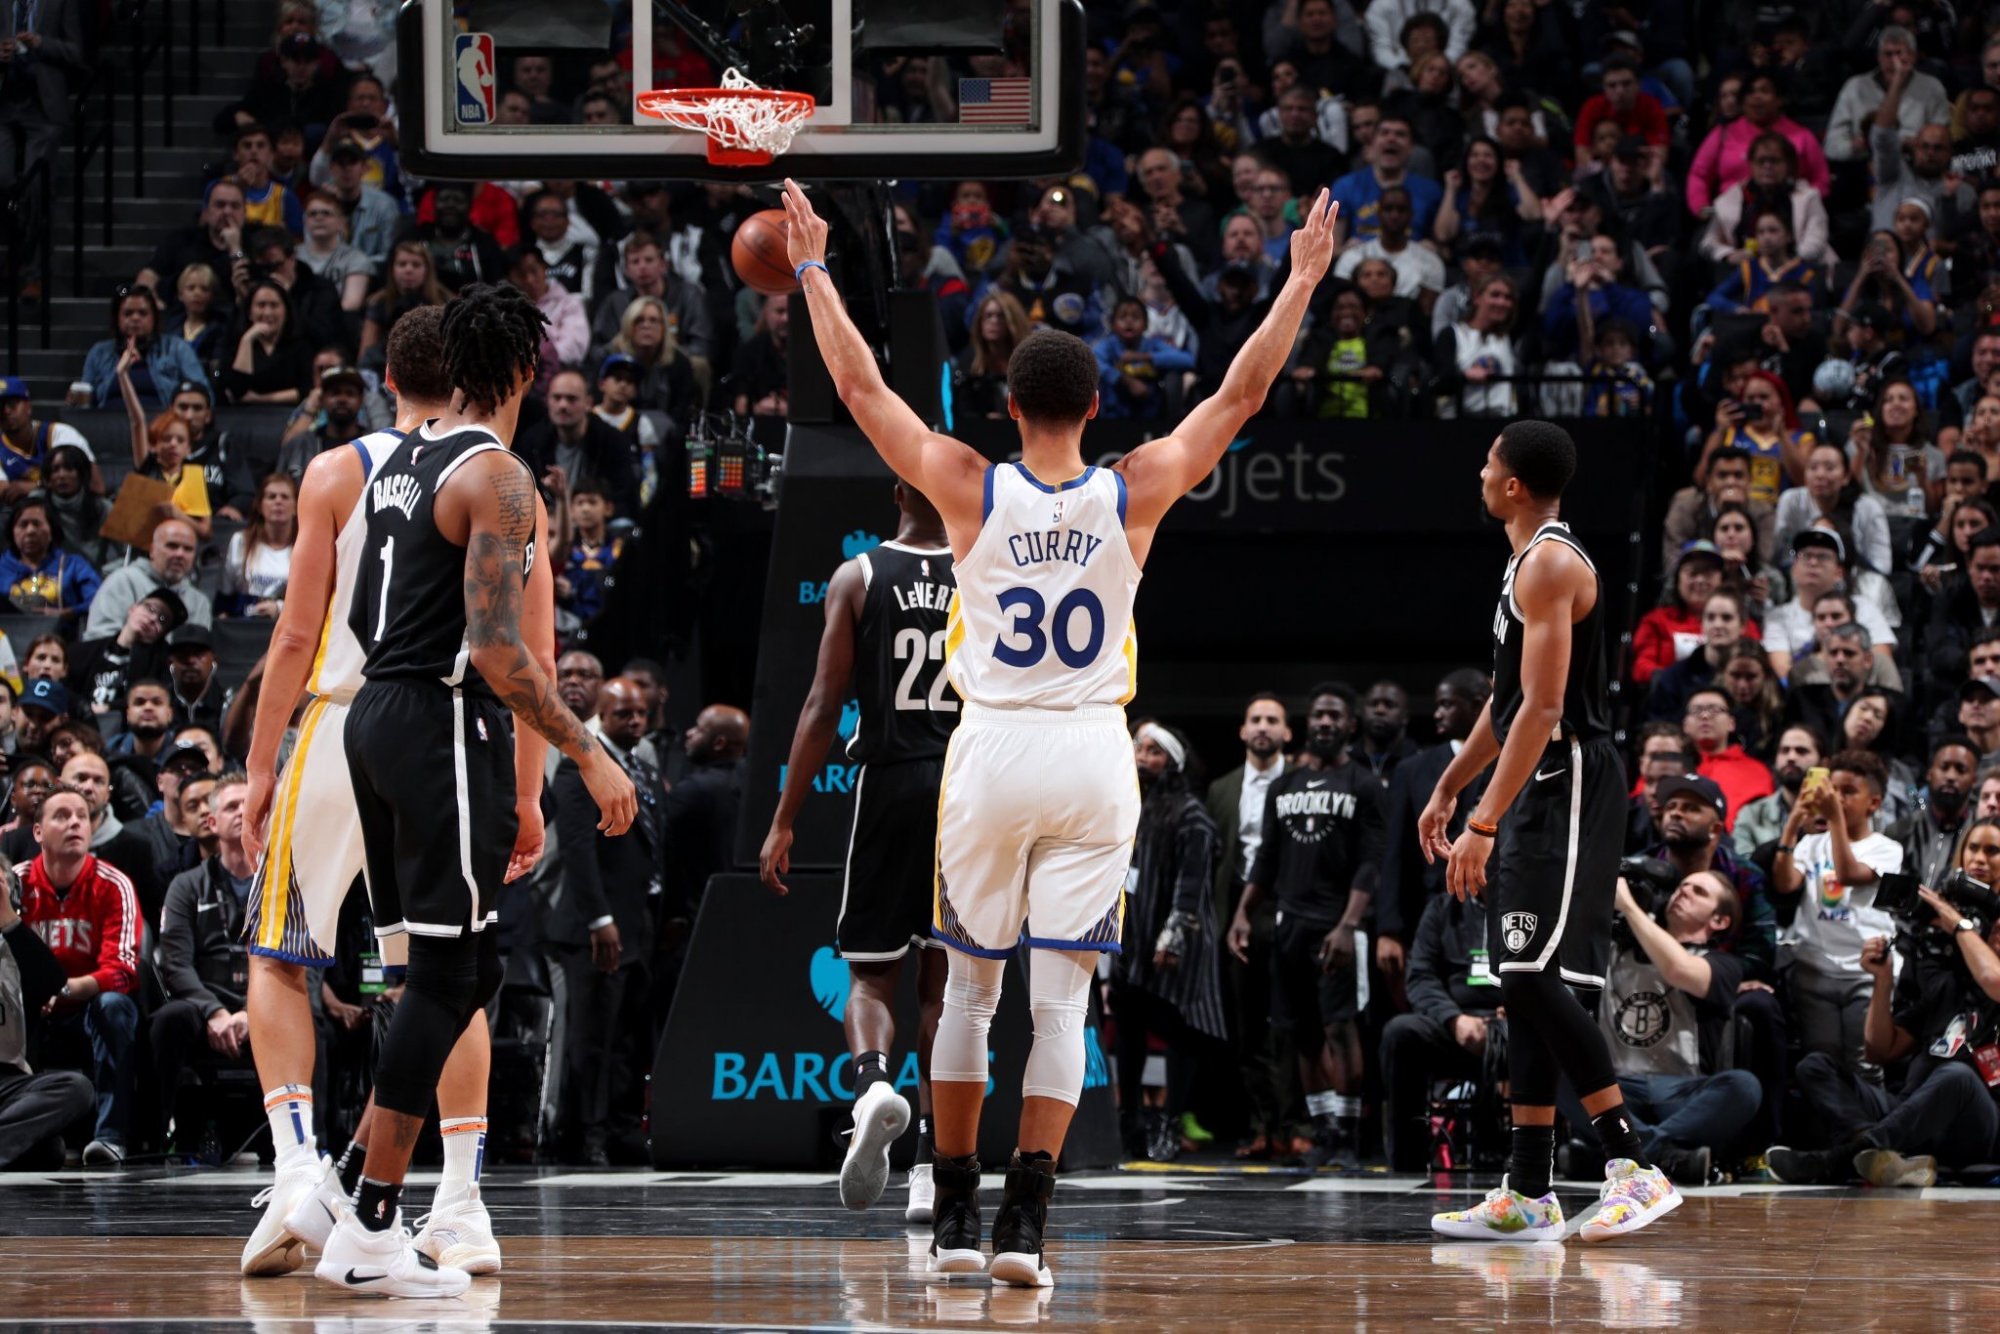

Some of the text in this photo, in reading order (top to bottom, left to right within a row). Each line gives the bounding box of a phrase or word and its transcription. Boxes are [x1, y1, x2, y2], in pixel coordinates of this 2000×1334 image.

[461, 104, 481, 119] NBA
[373, 473, 422, 521] RUSSELL
[1008, 529, 1102, 567] CURRY
[374, 535, 394, 642] 1
[992, 586, 1106, 669] 30
[894, 627, 958, 712] 22
[34, 681, 50, 697] C
[1275, 790, 1357, 820] BROOKLYN
[1503, 914, 1534, 933] NETS
[1635, 1006, 1648, 1033] B
